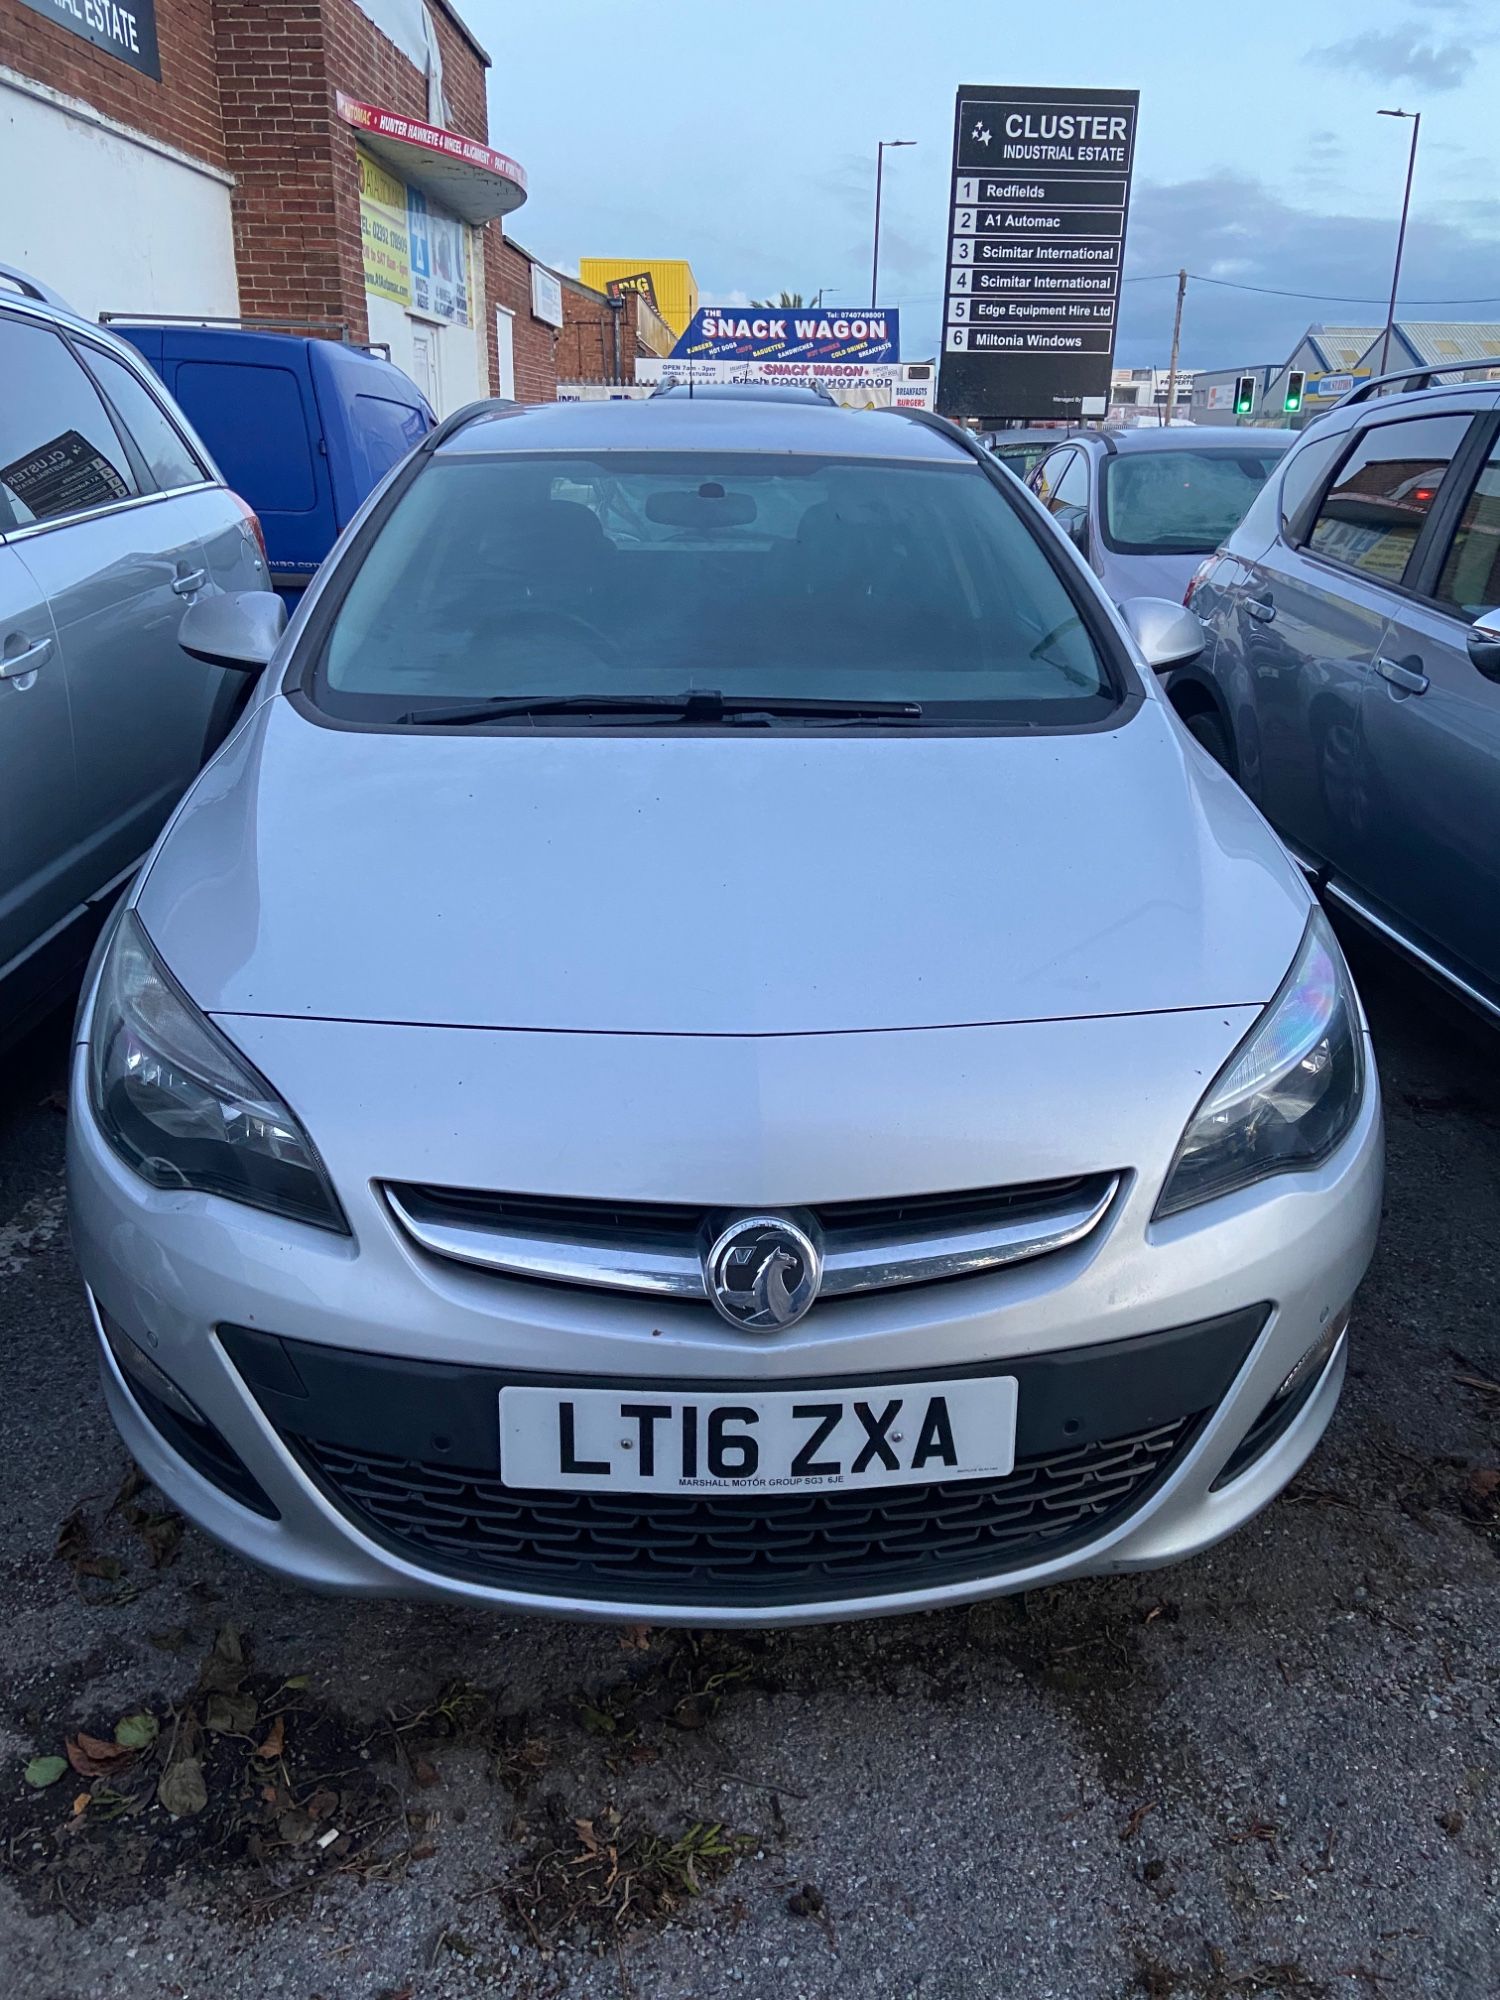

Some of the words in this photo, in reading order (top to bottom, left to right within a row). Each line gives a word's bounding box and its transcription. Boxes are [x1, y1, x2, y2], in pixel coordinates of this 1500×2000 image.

[85, 0, 140, 54] ESTATE
[1005, 114, 1127, 140] CLUSTER
[379, 115, 407, 136] HUNTER
[407, 123, 439, 147] HAWKEYE
[444, 136, 462, 155] WHEEL
[463, 143, 490, 165] ALIGNMENT
[1003, 145, 1075, 160] INDUSTRIAL
[1077, 147, 1124, 161] ESTATE
[963, 182, 971, 198] 1
[986, 184, 1045, 198] Redfields
[961, 213, 971, 228] 2
[984, 214, 1000, 226] A1
[1005, 214, 1060, 228] Automac
[959, 243, 969, 259] 3
[982, 245, 1034, 258] Scimitar
[1037, 247, 1113, 260] International
[957, 272, 967, 288] 4
[980, 275, 1031, 288] Scimitar
[1034, 276, 1110, 289] International
[955, 302, 965, 317] 5
[978, 304, 1006, 317] Edge
[1009, 304, 1066, 318] Equipment
[1069, 305, 1090, 316] Hire
[1093, 306, 1110, 316] Ltd
[702, 318, 787, 339] SNACK
[794, 319, 886, 339] WAGON
[953, 330, 963, 345] 6
[976, 334, 1023, 346] Miltonia
[1027, 334, 1082, 347] Windows
[708, 346, 720, 355] HOT
[721, 341, 737, 351] DOGS
[752, 342, 785, 357] BAGUETTES
[777, 342, 814, 358] SANDWICHES
[858, 342, 892, 358] BREAKFASTS
[762, 364, 811, 376] SNACK
[812, 364, 864, 377] WAGON
[859, 378, 892, 388] FOOD
[896, 387, 928, 396] BREAKFASTS
[896, 398, 926, 407] BURGERS
[558, 1402, 759, 1478] LT16
[790, 1396, 958, 1476] ZXA
[679, 1478, 729, 1487] MARSHALL
[732, 1478, 766, 1487] MOTOR
[769, 1477, 801, 1486] GROUP
[827, 1475, 844, 1484] 6JE
